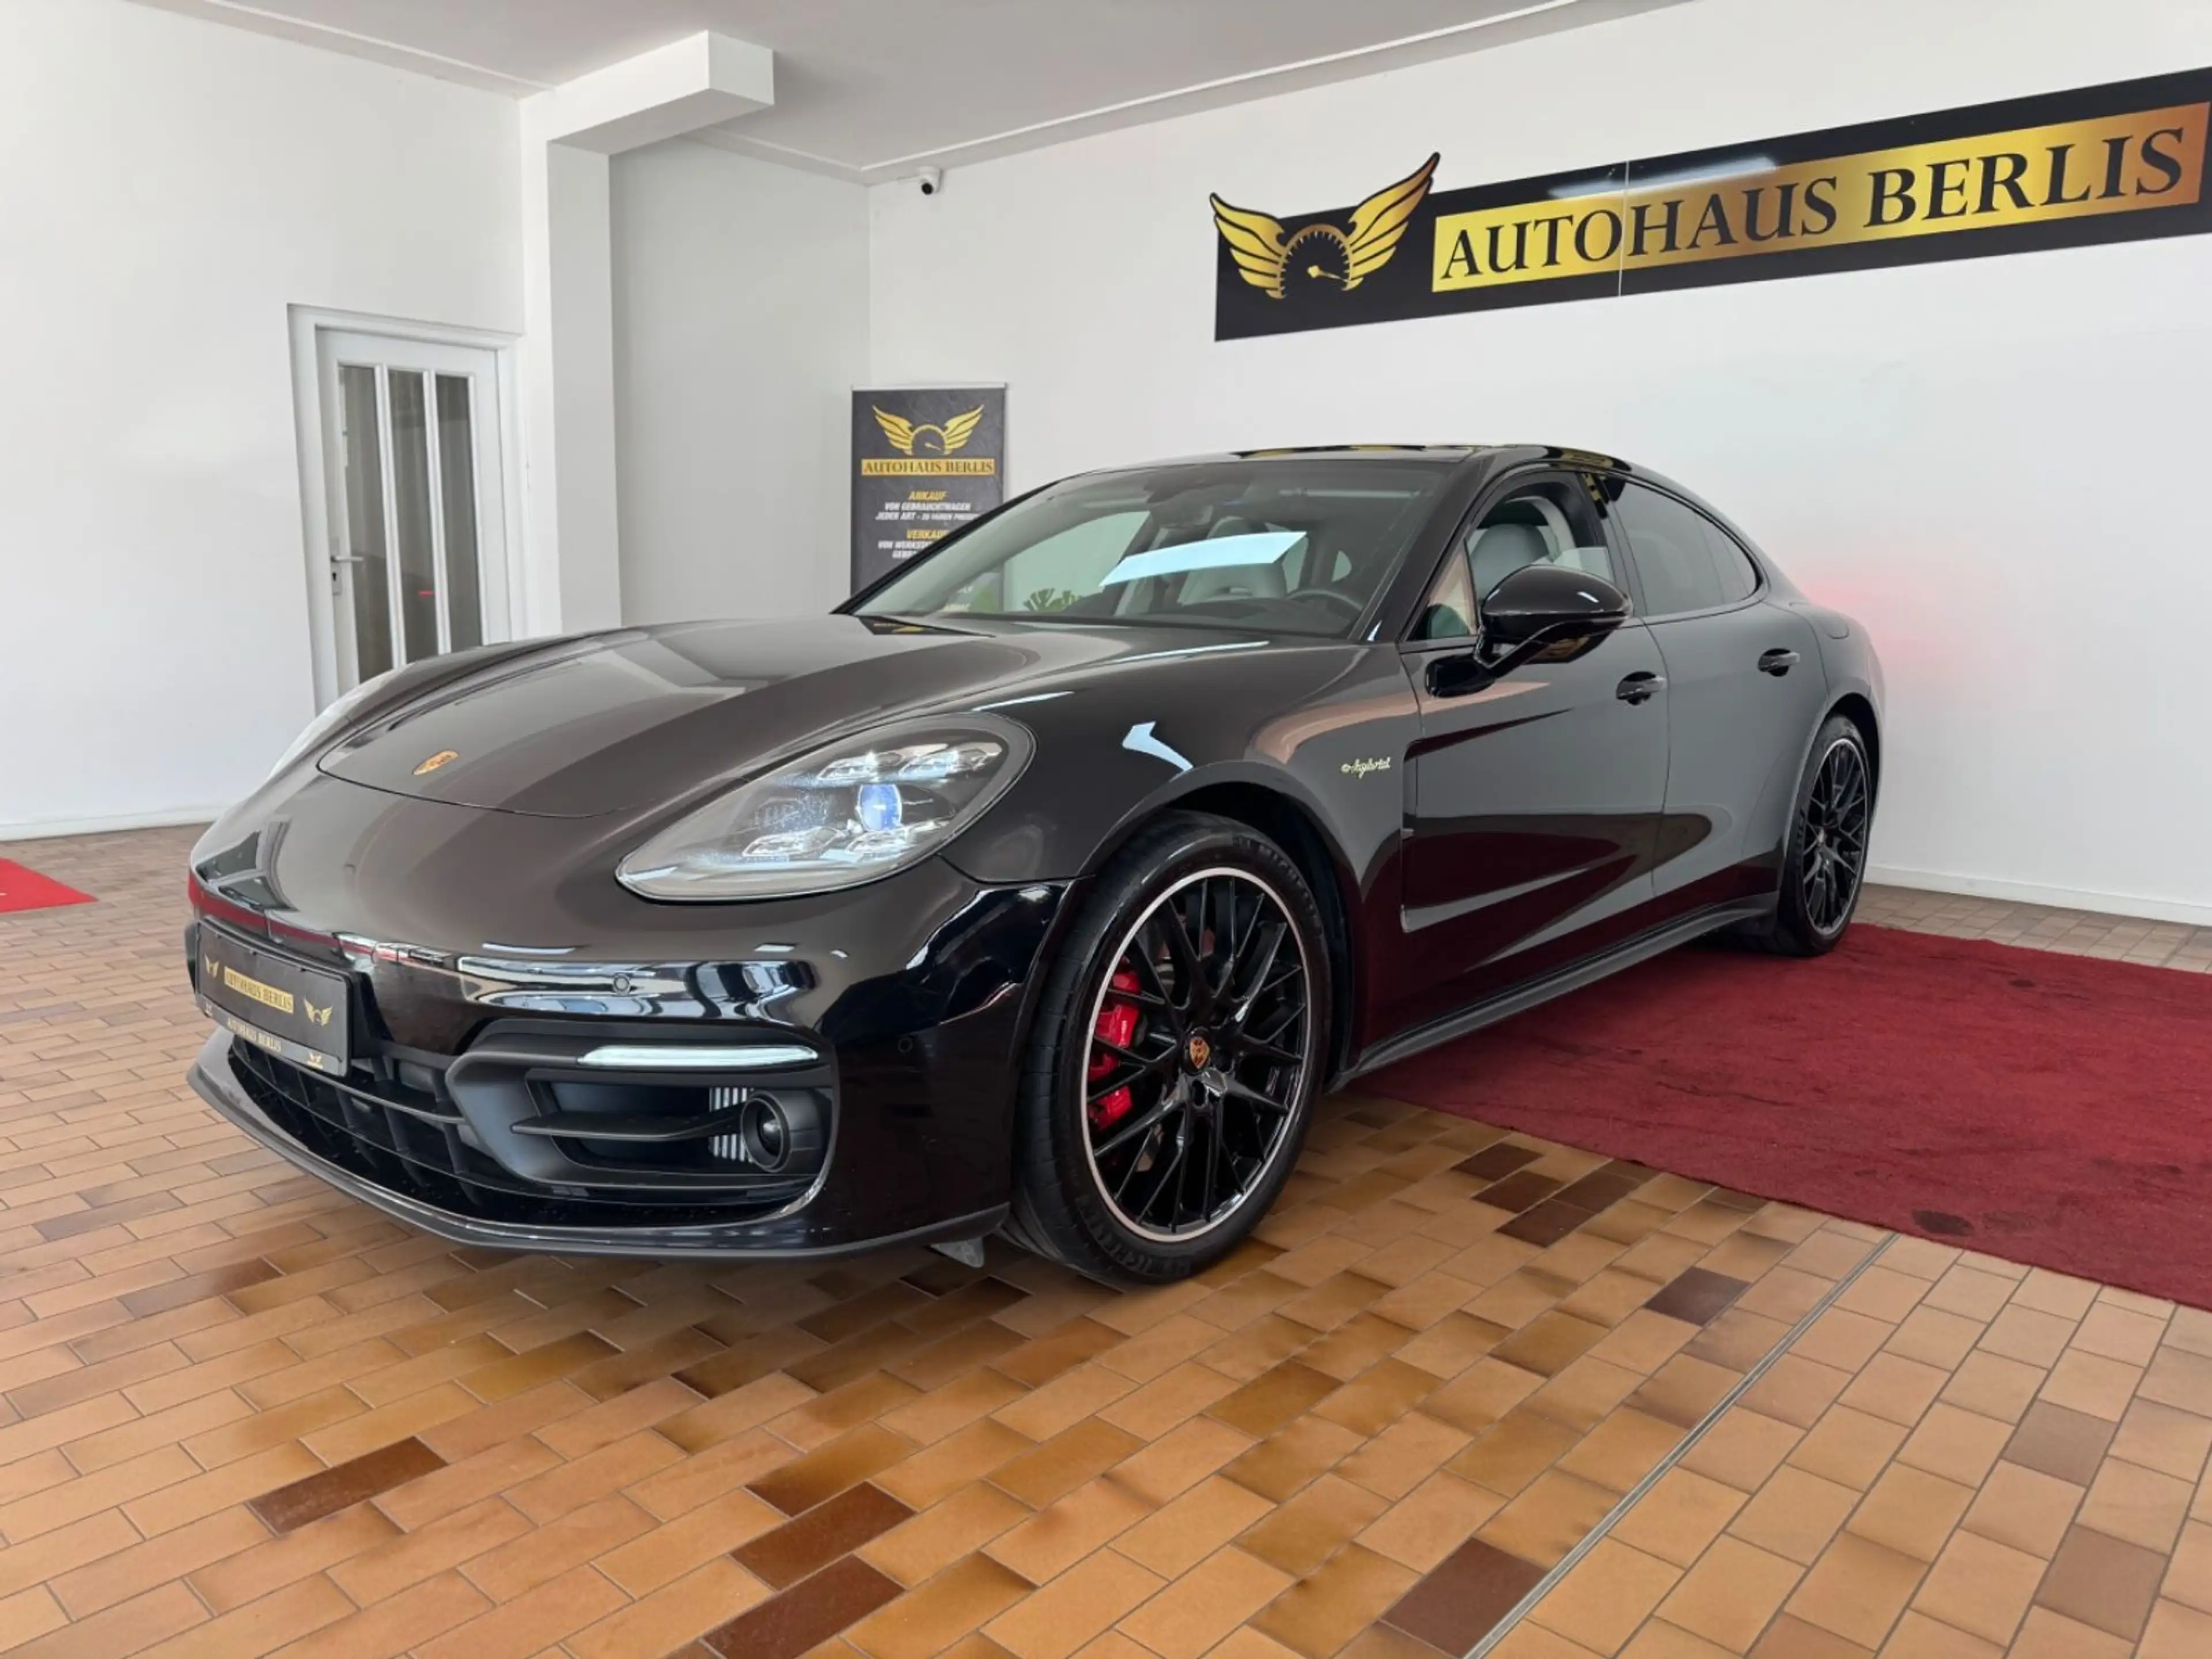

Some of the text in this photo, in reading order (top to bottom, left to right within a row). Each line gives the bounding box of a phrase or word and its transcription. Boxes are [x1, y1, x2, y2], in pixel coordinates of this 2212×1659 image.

[1440, 127, 2184, 280] AUTOHAUS BERLIS
[865, 460, 993, 473] AUTOHAUS BERLIS
[908, 490, 948, 500] ANKAUF
[263, 988, 292, 1010] BERLIS
